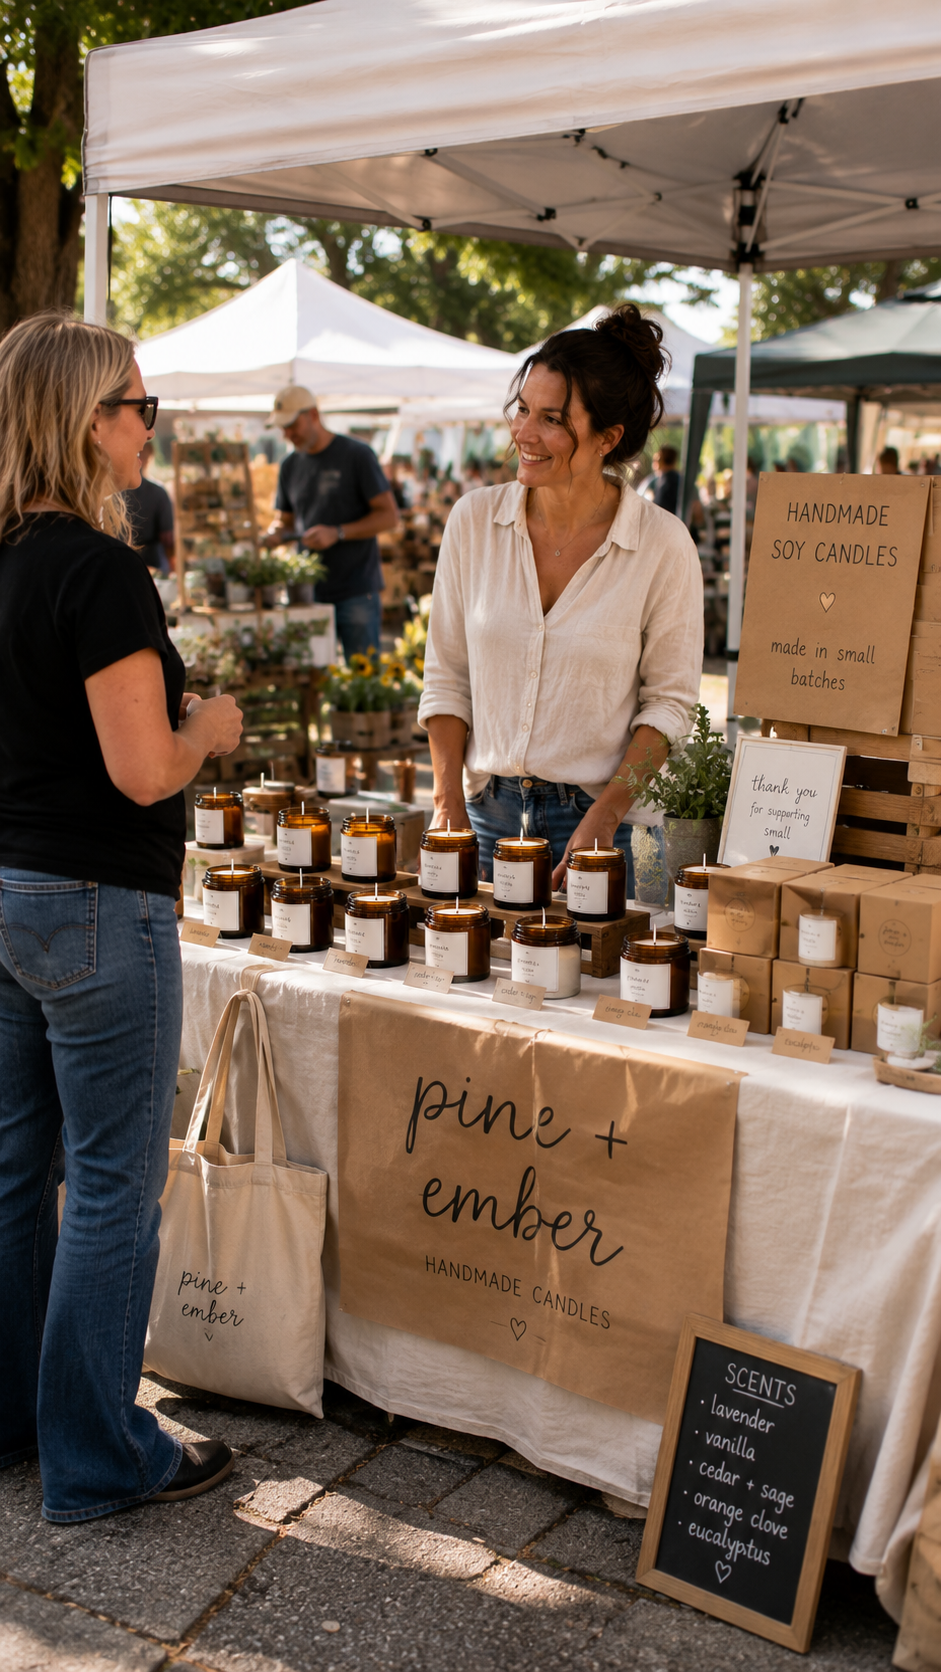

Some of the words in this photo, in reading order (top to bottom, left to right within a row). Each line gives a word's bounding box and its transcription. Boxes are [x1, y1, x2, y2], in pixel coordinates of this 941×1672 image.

[787, 502, 890, 526] HANDMADE
[771, 539, 806, 560] SOY
[814, 541, 898, 567] CANDLES
[771, 637, 807, 656] made
[815, 642, 828, 659] in
[837, 645, 875, 664] small
[791, 667, 845, 691] batches
[751, 774, 790, 794] thank
[794, 788, 818, 804] you
[749, 801, 763, 817] for
[767, 807, 810, 827] supporting
[763, 825, 791, 840] small
[405, 1076, 572, 1155] pine
[594, 1120, 628, 1159] +
[421, 1165, 624, 1267] ember
[177, 1270, 228, 1296] pine
[236, 1281, 247, 1295] +
[425, 1255, 522, 1297] HANDMADE
[532, 1285, 611, 1330] CANDLES
[181, 1299, 244, 1327] ember
[724, 1362, 797, 1406] SCENTS
[710, 1393, 775, 1433] lavender
[705, 1431, 756, 1461] vanilla
[699, 1461, 740, 1486] cedar
[746, 1479, 755, 1491] +
[760, 1483, 794, 1514] sage
[693, 1492, 743, 1527] orange
[750, 1509, 788, 1540] clove
[688, 1521, 771, 1566] eucalyptus
